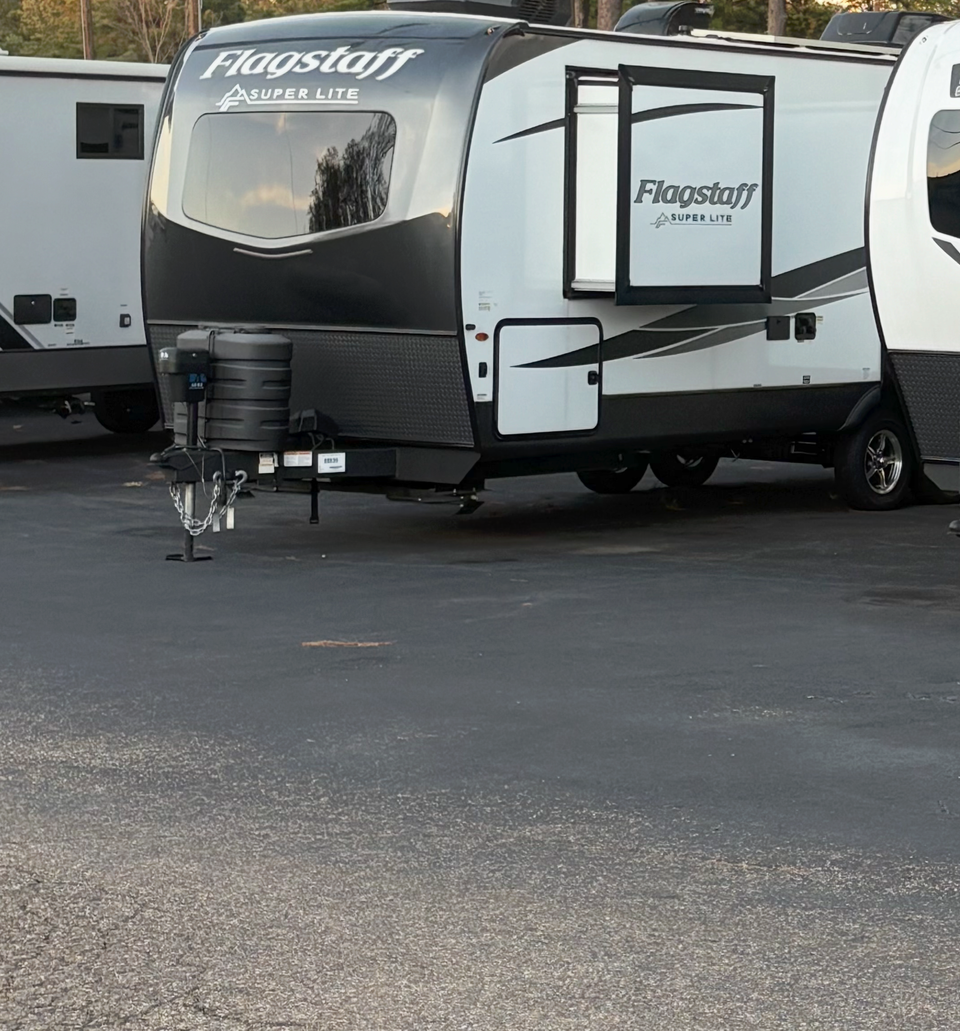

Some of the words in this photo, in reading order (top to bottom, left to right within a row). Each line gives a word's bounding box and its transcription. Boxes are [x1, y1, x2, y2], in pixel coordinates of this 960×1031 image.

[199, 45, 425, 81] Flagstaff
[249, 87, 309, 100] SUPER
[315, 87, 360, 100] LITE
[633, 179, 759, 210] Flagstaff
[671, 213, 706, 222] SUPER
[709, 214, 733, 223] LITE
